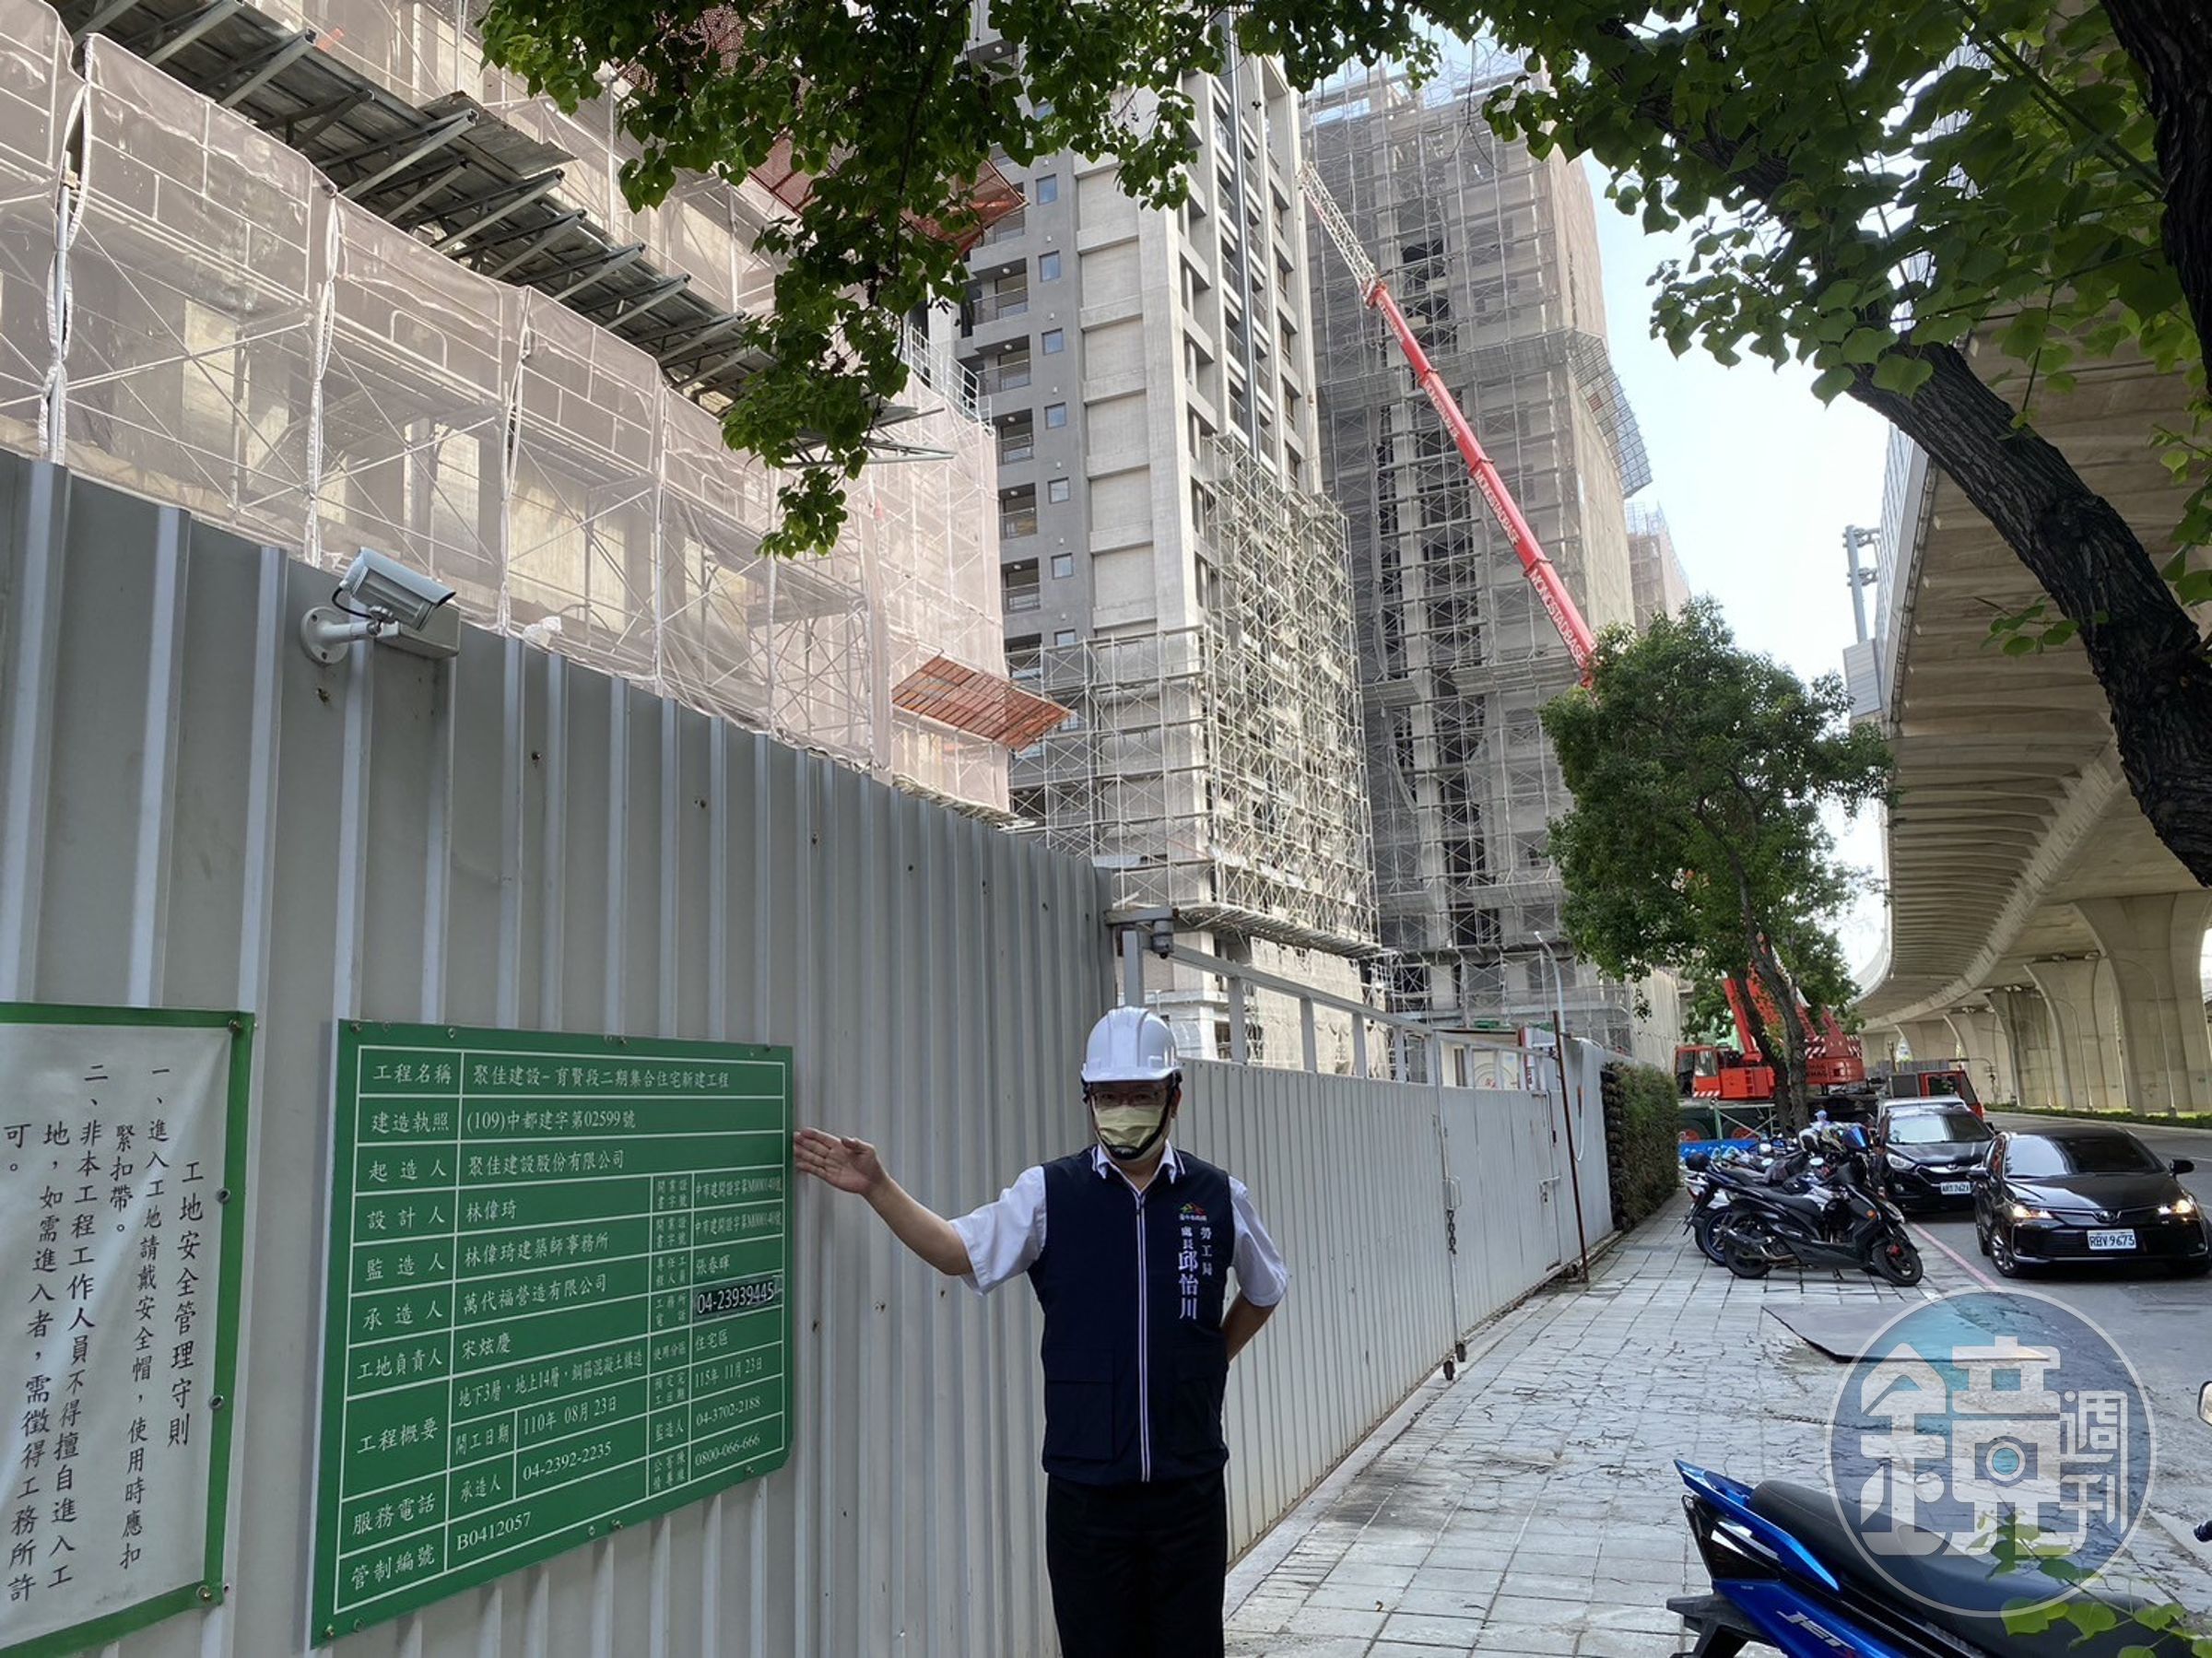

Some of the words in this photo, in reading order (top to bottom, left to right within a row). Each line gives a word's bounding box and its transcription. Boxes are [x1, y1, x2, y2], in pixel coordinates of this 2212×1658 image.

[373, 1063, 453, 1084] 工程名稱
[371, 1111, 449, 1135] 建造執照
[466, 1110, 636, 1135] (109)中都建字第02599號
[369, 1159, 446, 1182] 起造人
[468, 1149, 624, 1177] 聚佳建設股份有限公司
[367, 1205, 445, 1230] 設計人
[466, 1200, 517, 1224] 林偉琦
[465, 1232, 608, 1267] 林偉琦建築師事務所
[365, 1252, 445, 1281] 監造人
[167, 1161, 204, 1448] 工地安全管理守則
[464, 1274, 606, 1315] 萬代福營造有限公司
[697, 1282, 775, 1314] 04-23939445
[363, 1300, 442, 1330] 承造人
[695, 1328, 729, 1352] 住宅區
[357, 1348, 442, 1379] 工地負責人
[523, 1412, 557, 1436] 110年
[564, 1401, 590, 1425] 08月
[594, 1395, 618, 1418] 23日
[696, 1395, 761, 1427] 04-3702-2188
[357, 1417, 439, 1453] 工程概要
[455, 1424, 511, 1456] 開工日期
[523, 1441, 612, 1480] 04-2392-2235
[461, 1474, 502, 1503] 承造人
[354, 1494, 436, 1535] 服務電話
[456, 1511, 532, 1551] B0412057
[351, 1548, 436, 1591] 管制編號
